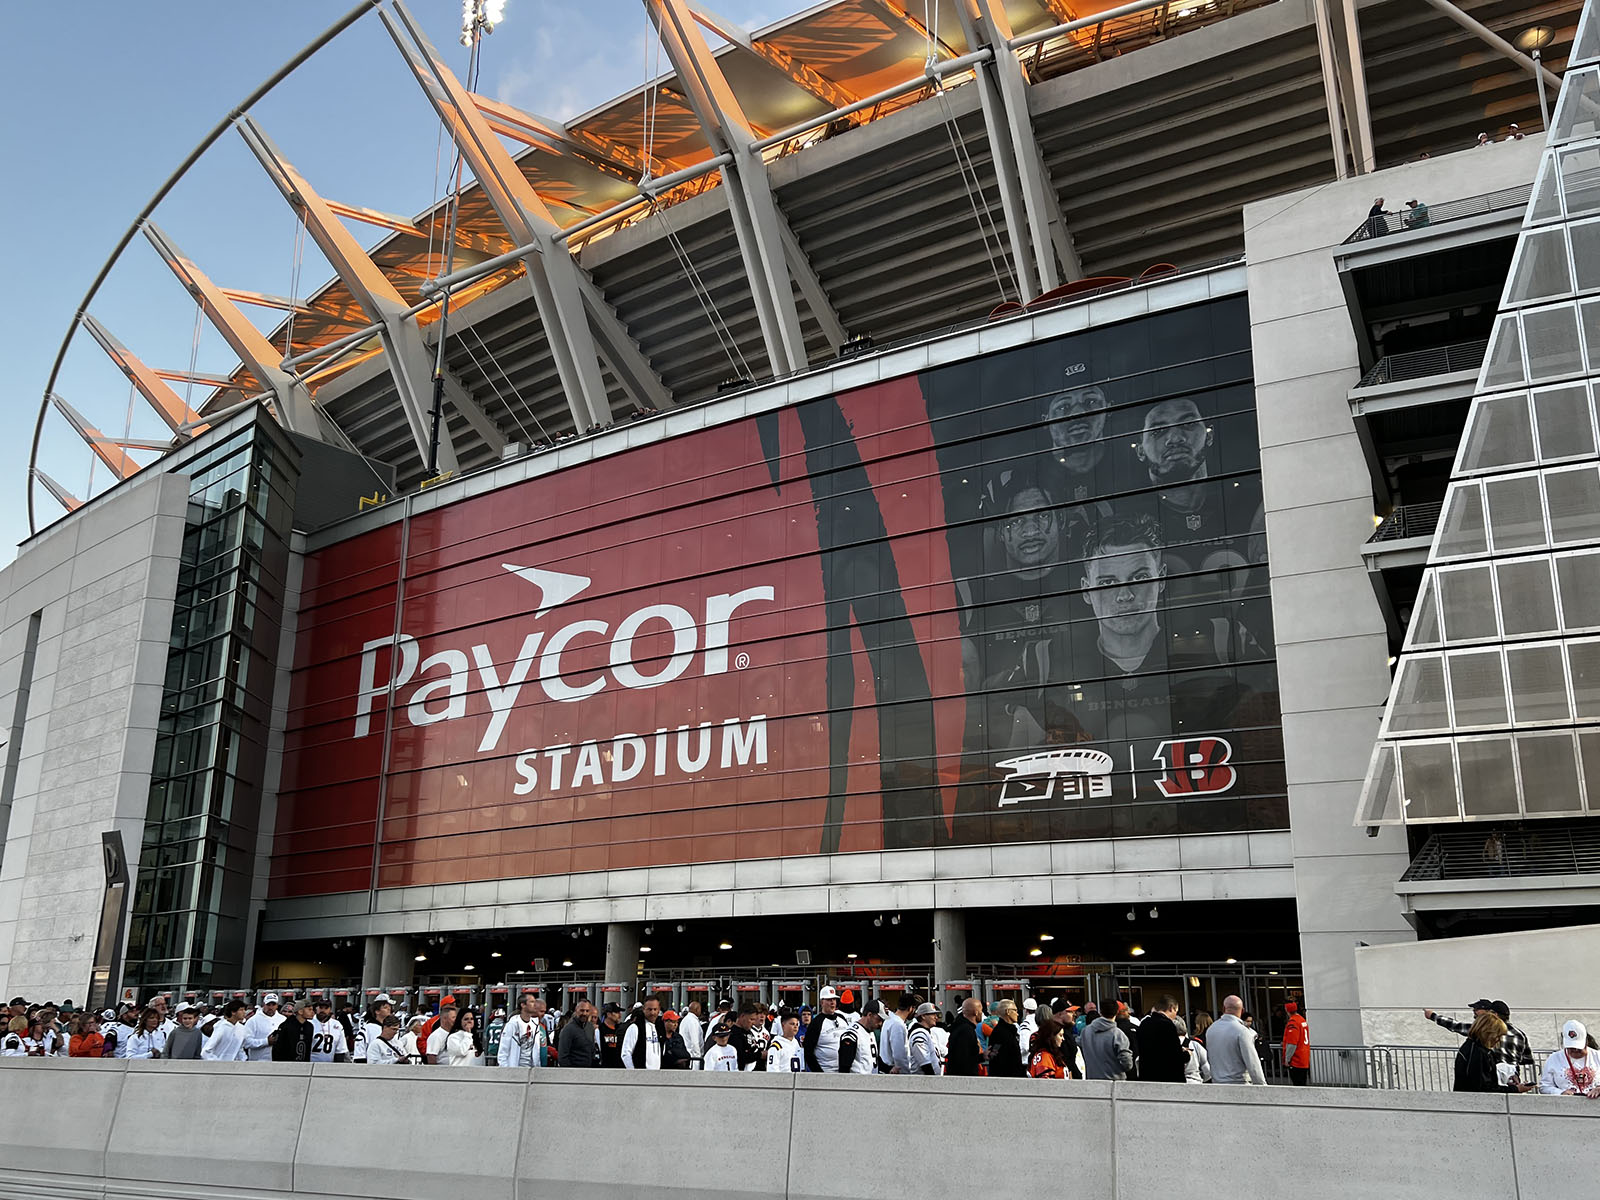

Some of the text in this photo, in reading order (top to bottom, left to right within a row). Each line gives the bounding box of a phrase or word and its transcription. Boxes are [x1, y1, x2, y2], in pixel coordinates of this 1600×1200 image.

[352, 585, 775, 753] Paycor
[1087, 694, 1177, 711] BENGALS
[513, 714, 769, 796] STADIUM
[311, 1033, 334, 1054] 28
[768, 1054, 774, 1065] 9
[870, 1043, 878, 1069] 9
